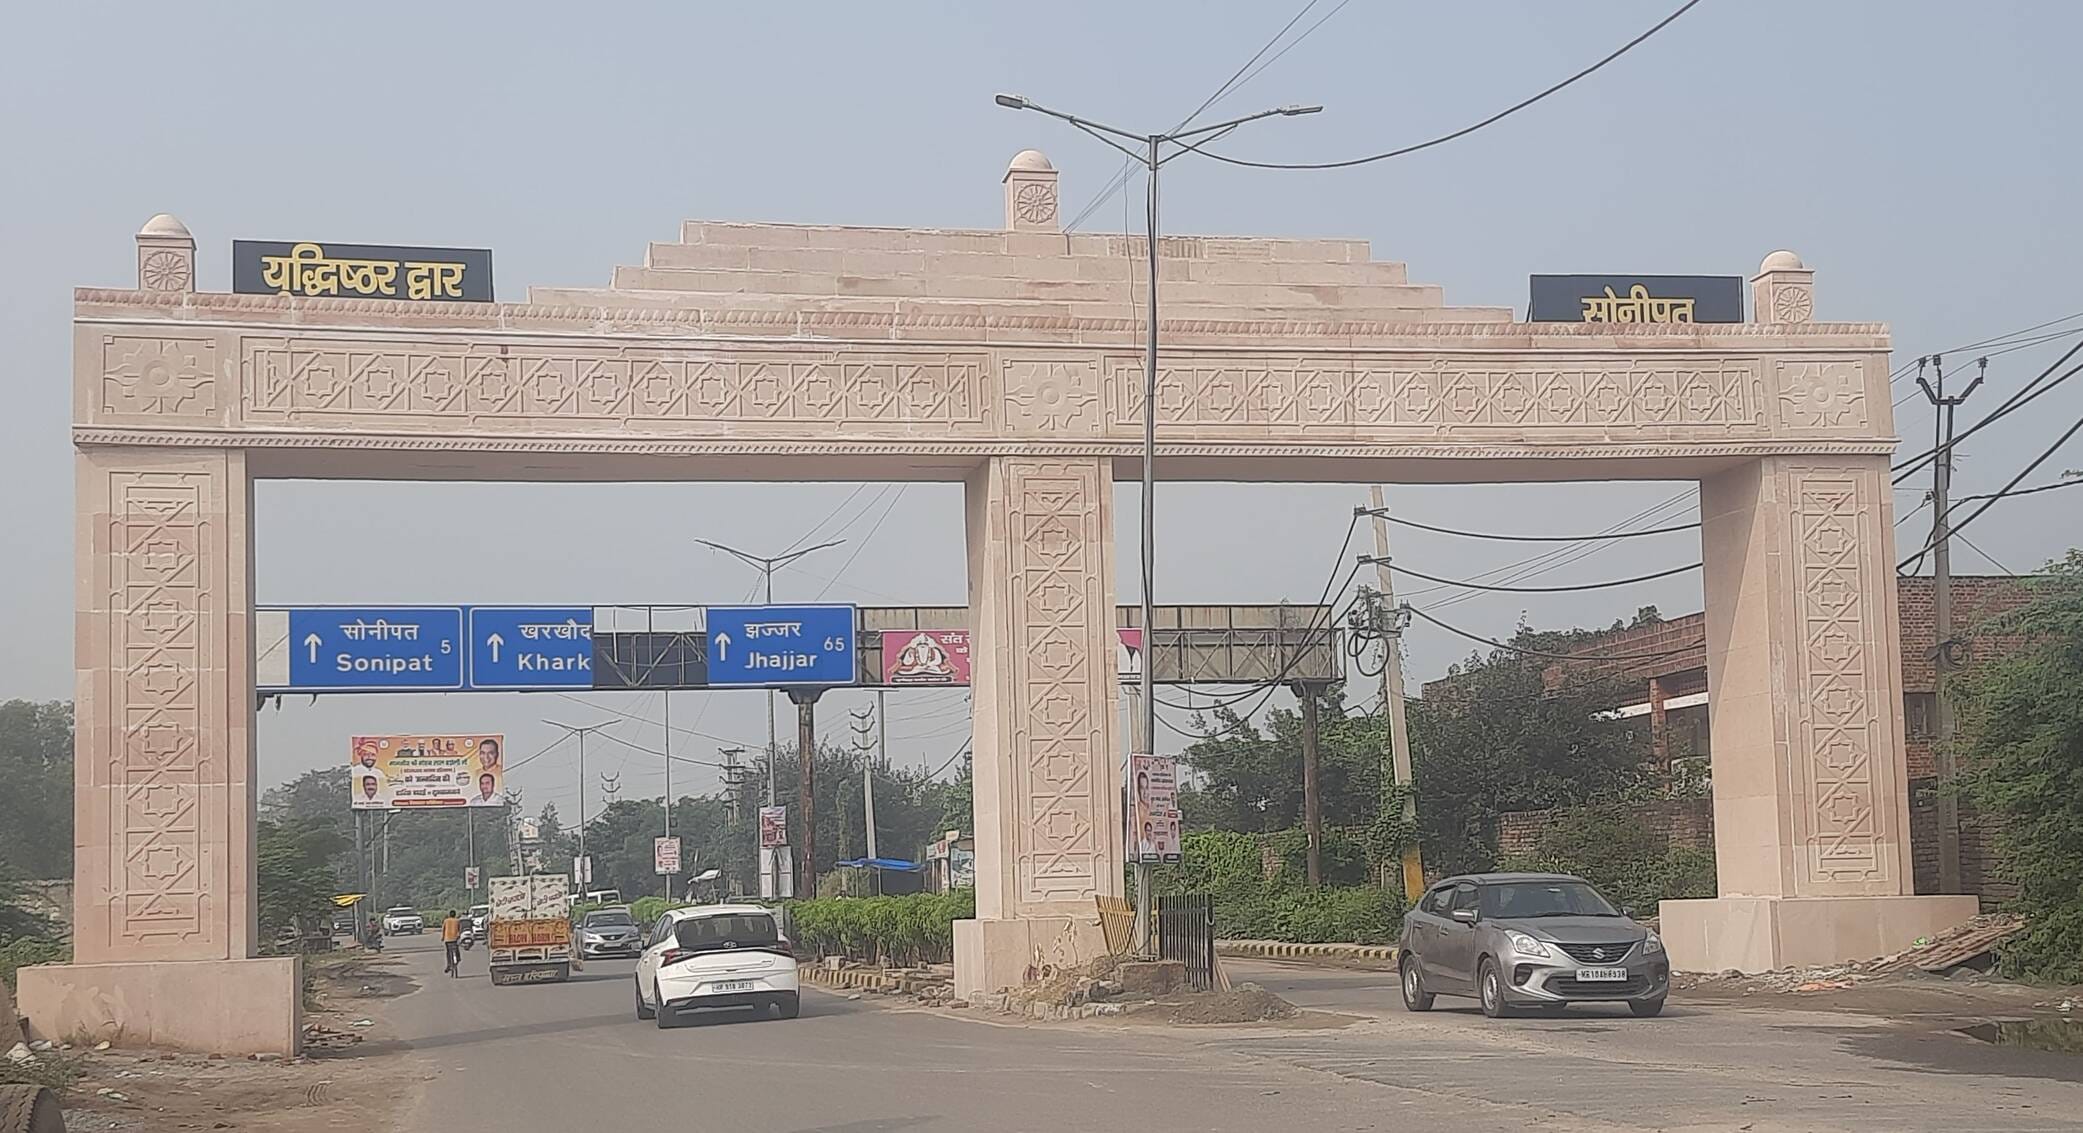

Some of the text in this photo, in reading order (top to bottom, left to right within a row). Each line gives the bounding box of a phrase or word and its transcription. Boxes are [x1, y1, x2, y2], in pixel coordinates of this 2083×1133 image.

[404, 261, 466, 300] द्वार
[1581, 284, 1695, 323] सोनीपत
[338, 618, 420, 641] सोनीपत
[743, 622, 802, 640] झज्जर
[440, 639, 452, 655] 5
[823, 636, 845, 652] 65
[335, 653, 433, 675] Sonipat
[517, 653, 593, 671] Khark
[743, 650, 818, 671] Jhajjar
